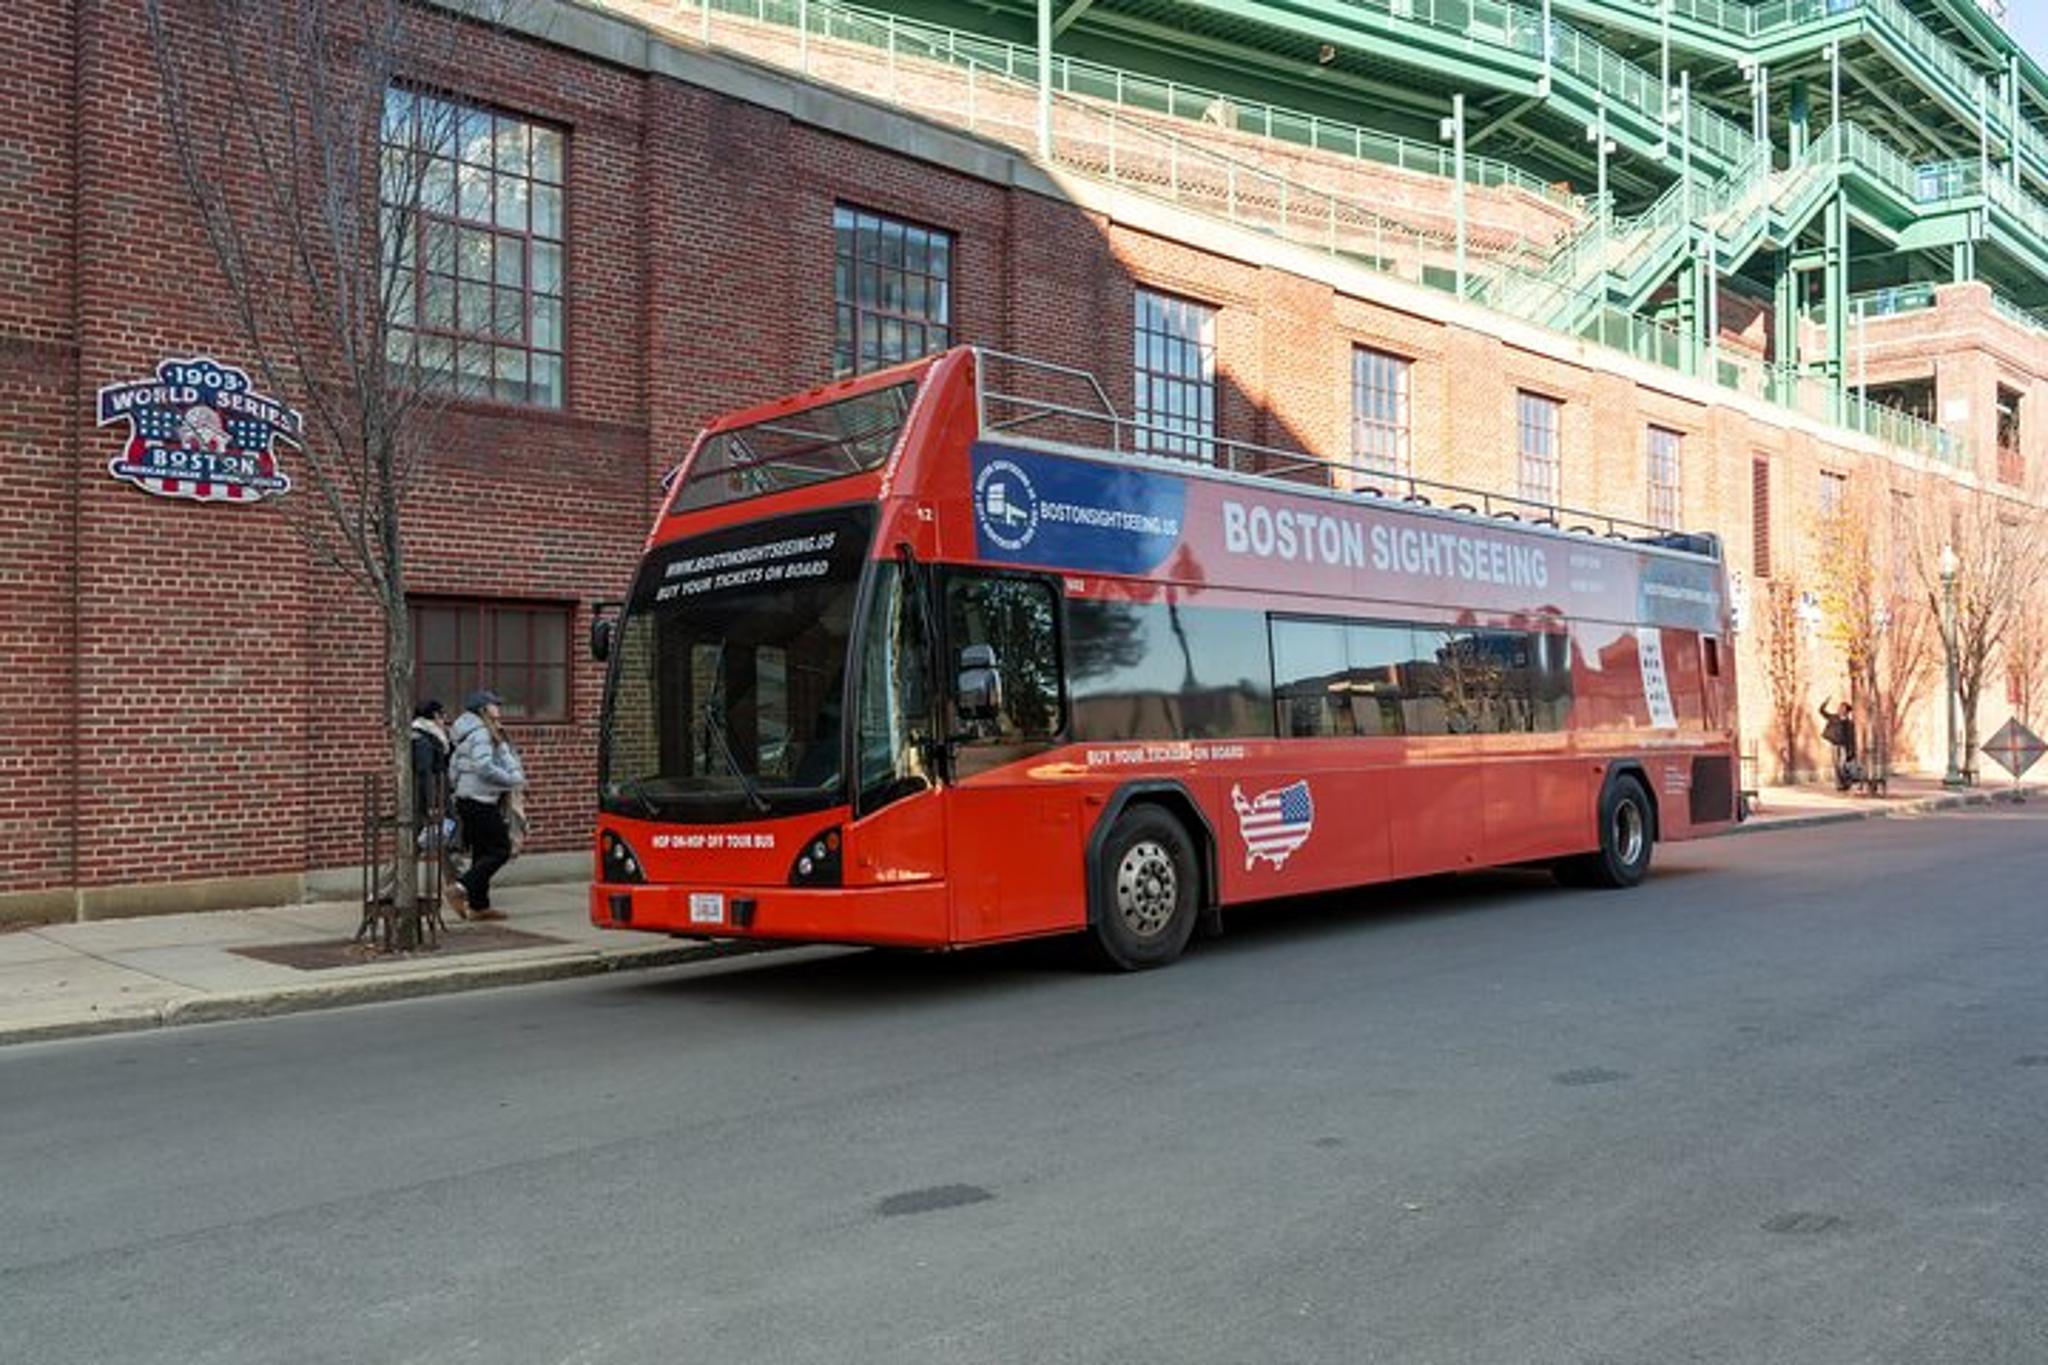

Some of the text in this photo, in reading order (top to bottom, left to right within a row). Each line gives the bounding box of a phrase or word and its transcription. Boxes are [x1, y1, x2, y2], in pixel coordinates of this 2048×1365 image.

[174, 366, 238, 390] 1903
[112, 386, 199, 411] WORLD
[152, 449, 256, 475] BOSTON
[1040, 500, 1179, 536] BOSTONSIGHTSEEING.US
[1222, 501, 1549, 588] BOSTON SIGHTSEEING
[656, 560, 829, 601] BUY YOUR TICKETS ON BOARD
[1086, 750, 1111, 765] BUY
[1114, 749, 1144, 764] YOUR
[726, 834, 752, 849] TOUR
[753, 834, 775, 849] BUS
